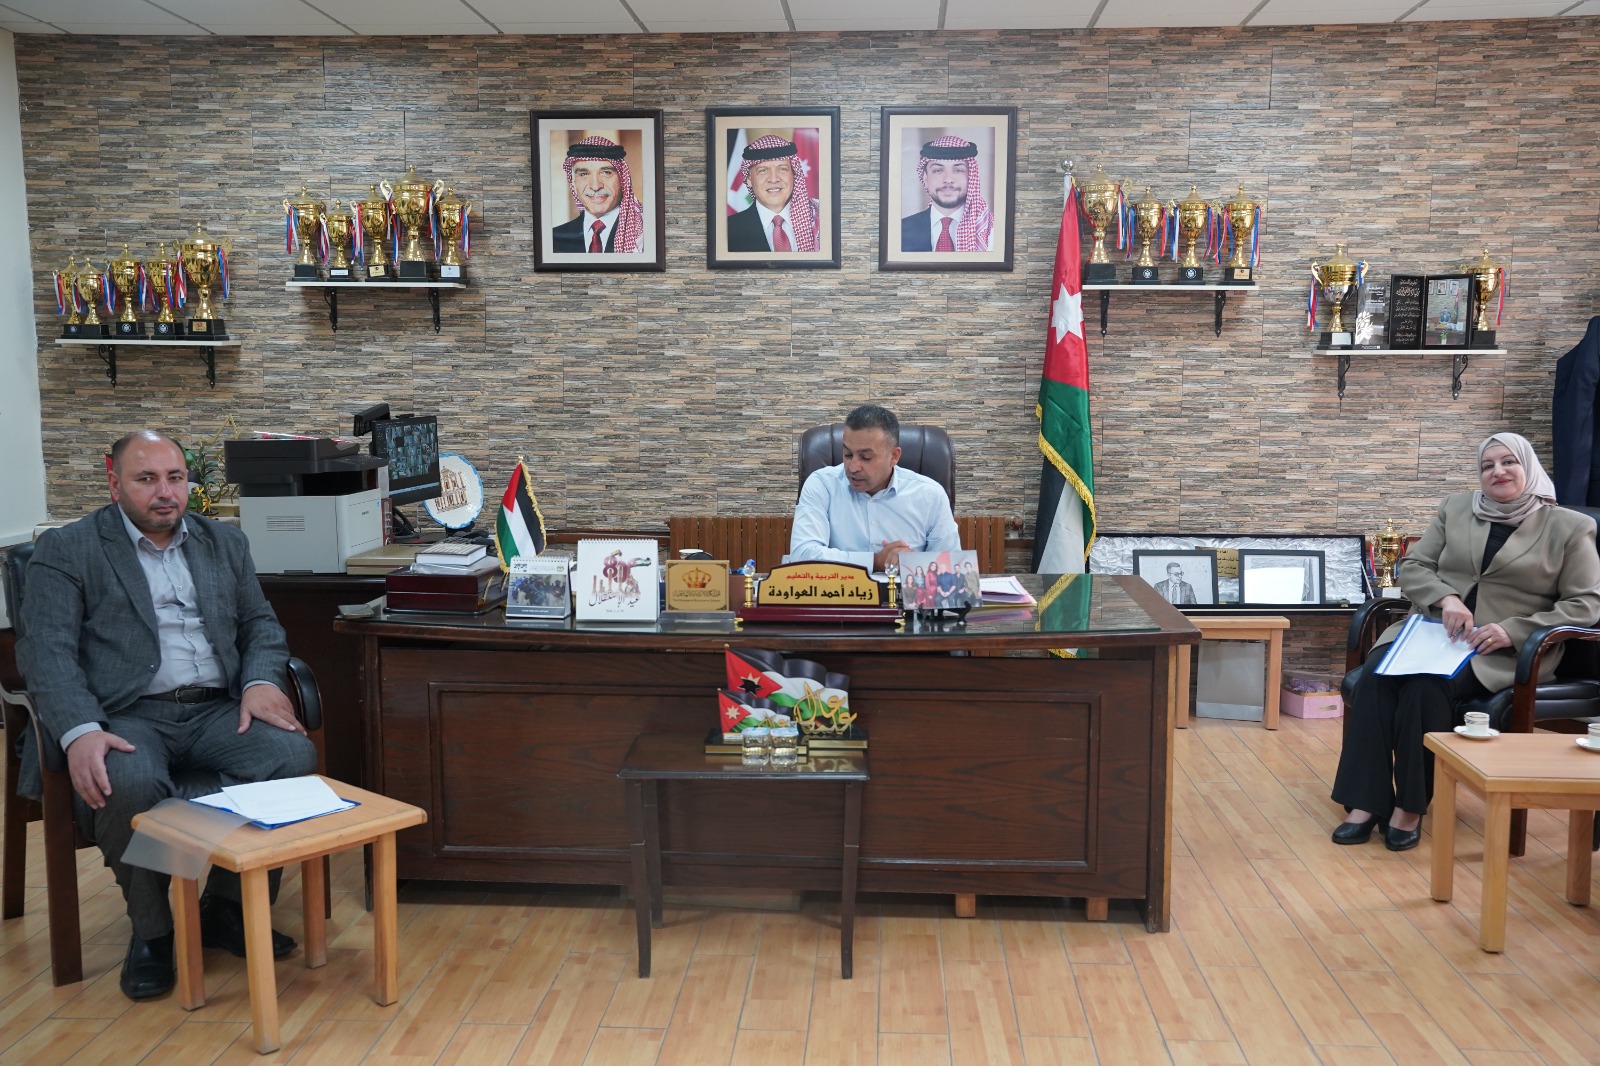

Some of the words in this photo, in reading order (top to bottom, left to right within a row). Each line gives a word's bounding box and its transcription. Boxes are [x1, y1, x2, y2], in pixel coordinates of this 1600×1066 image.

[603, 556, 629, 583] 80
[768, 585, 817, 599] العواودة
[820, 585, 845, 598] أحمد
[848, 587, 873, 600] زياد
[627, 596, 640, 608] عيد
